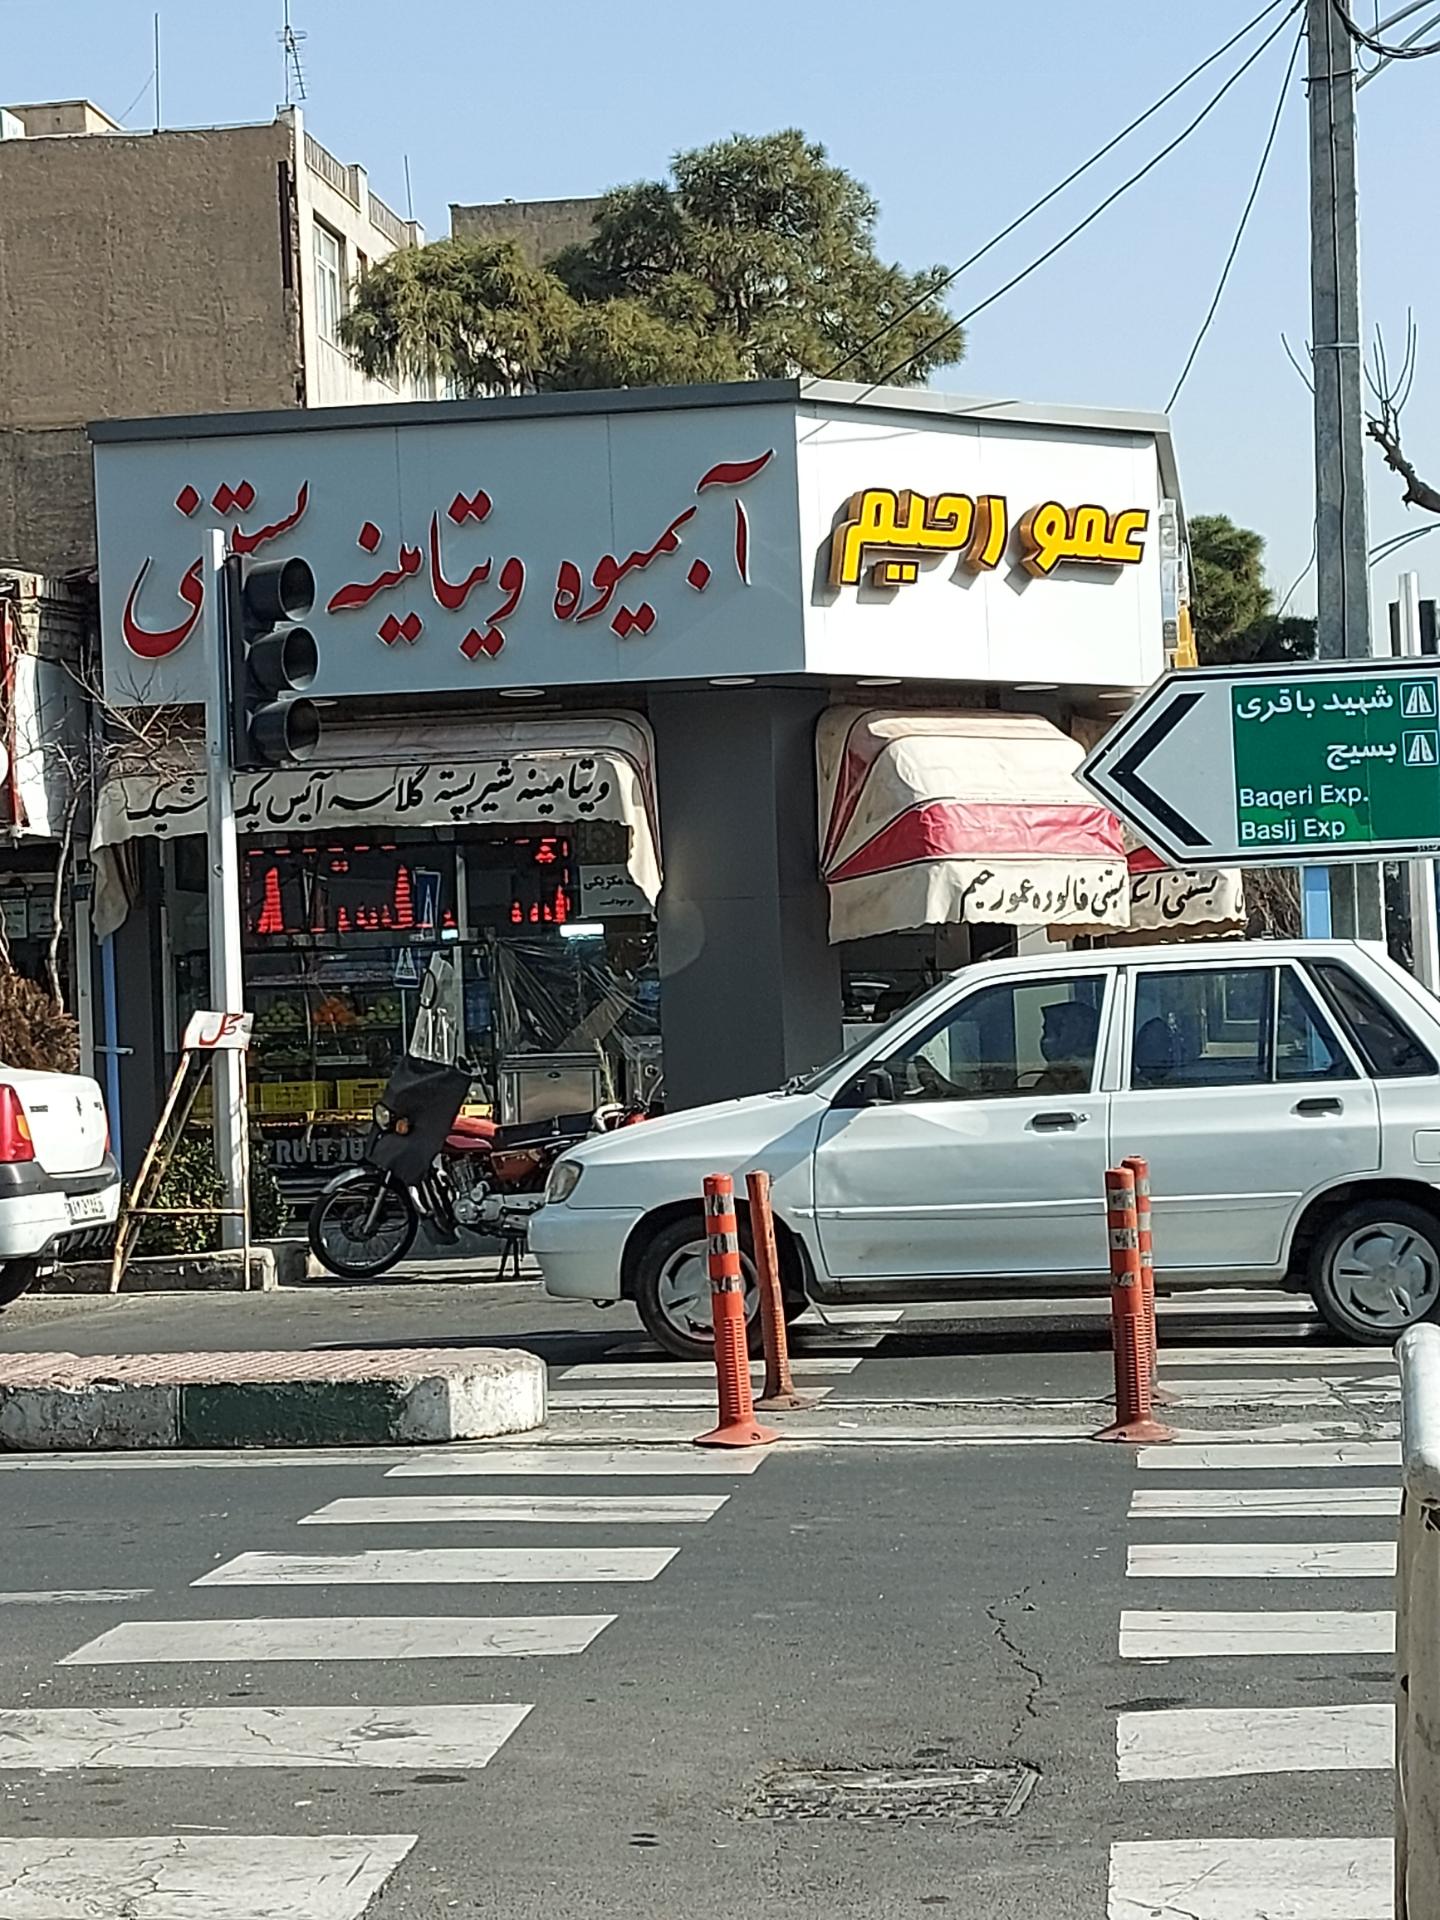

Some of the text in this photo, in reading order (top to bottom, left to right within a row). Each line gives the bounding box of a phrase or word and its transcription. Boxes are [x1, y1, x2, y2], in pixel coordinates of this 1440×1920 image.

[552, 447, 776, 639] آبمیوه
[835, 487, 1150, 587] عمو رحیم
[1236, 684, 1394, 723] شهید باقری
[1325, 737, 1398, 771] بسیج
[265, 770, 334, 825] آیس
[1240, 784, 1370, 810] Baqeri Exp.
[1241, 820, 1346, 843] Basij Exp
[1161, 869, 1219, 920] بستنی
